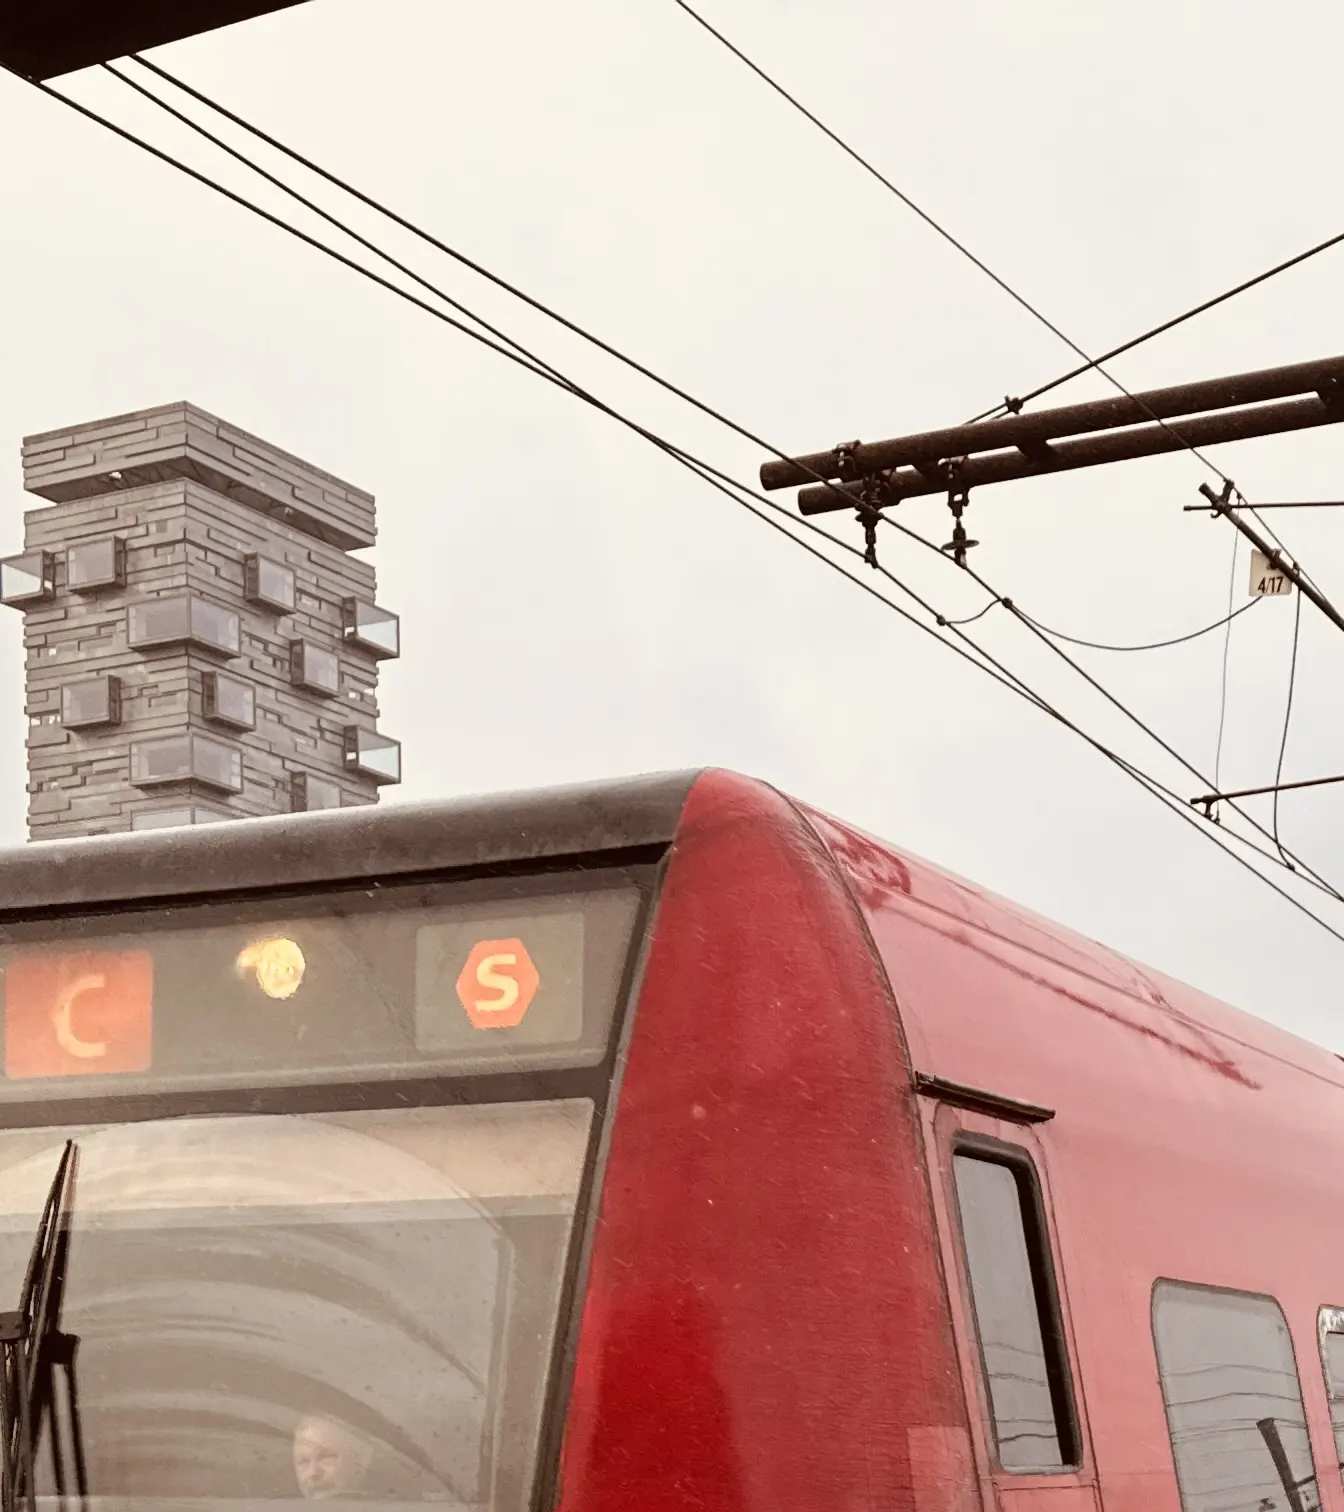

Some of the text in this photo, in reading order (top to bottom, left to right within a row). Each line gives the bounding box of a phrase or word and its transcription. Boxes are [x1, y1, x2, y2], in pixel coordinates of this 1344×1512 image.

[1257, 576, 1284, 594] 4/17
[474, 953, 520, 1013] S
[57, 974, 106, 1058] C
